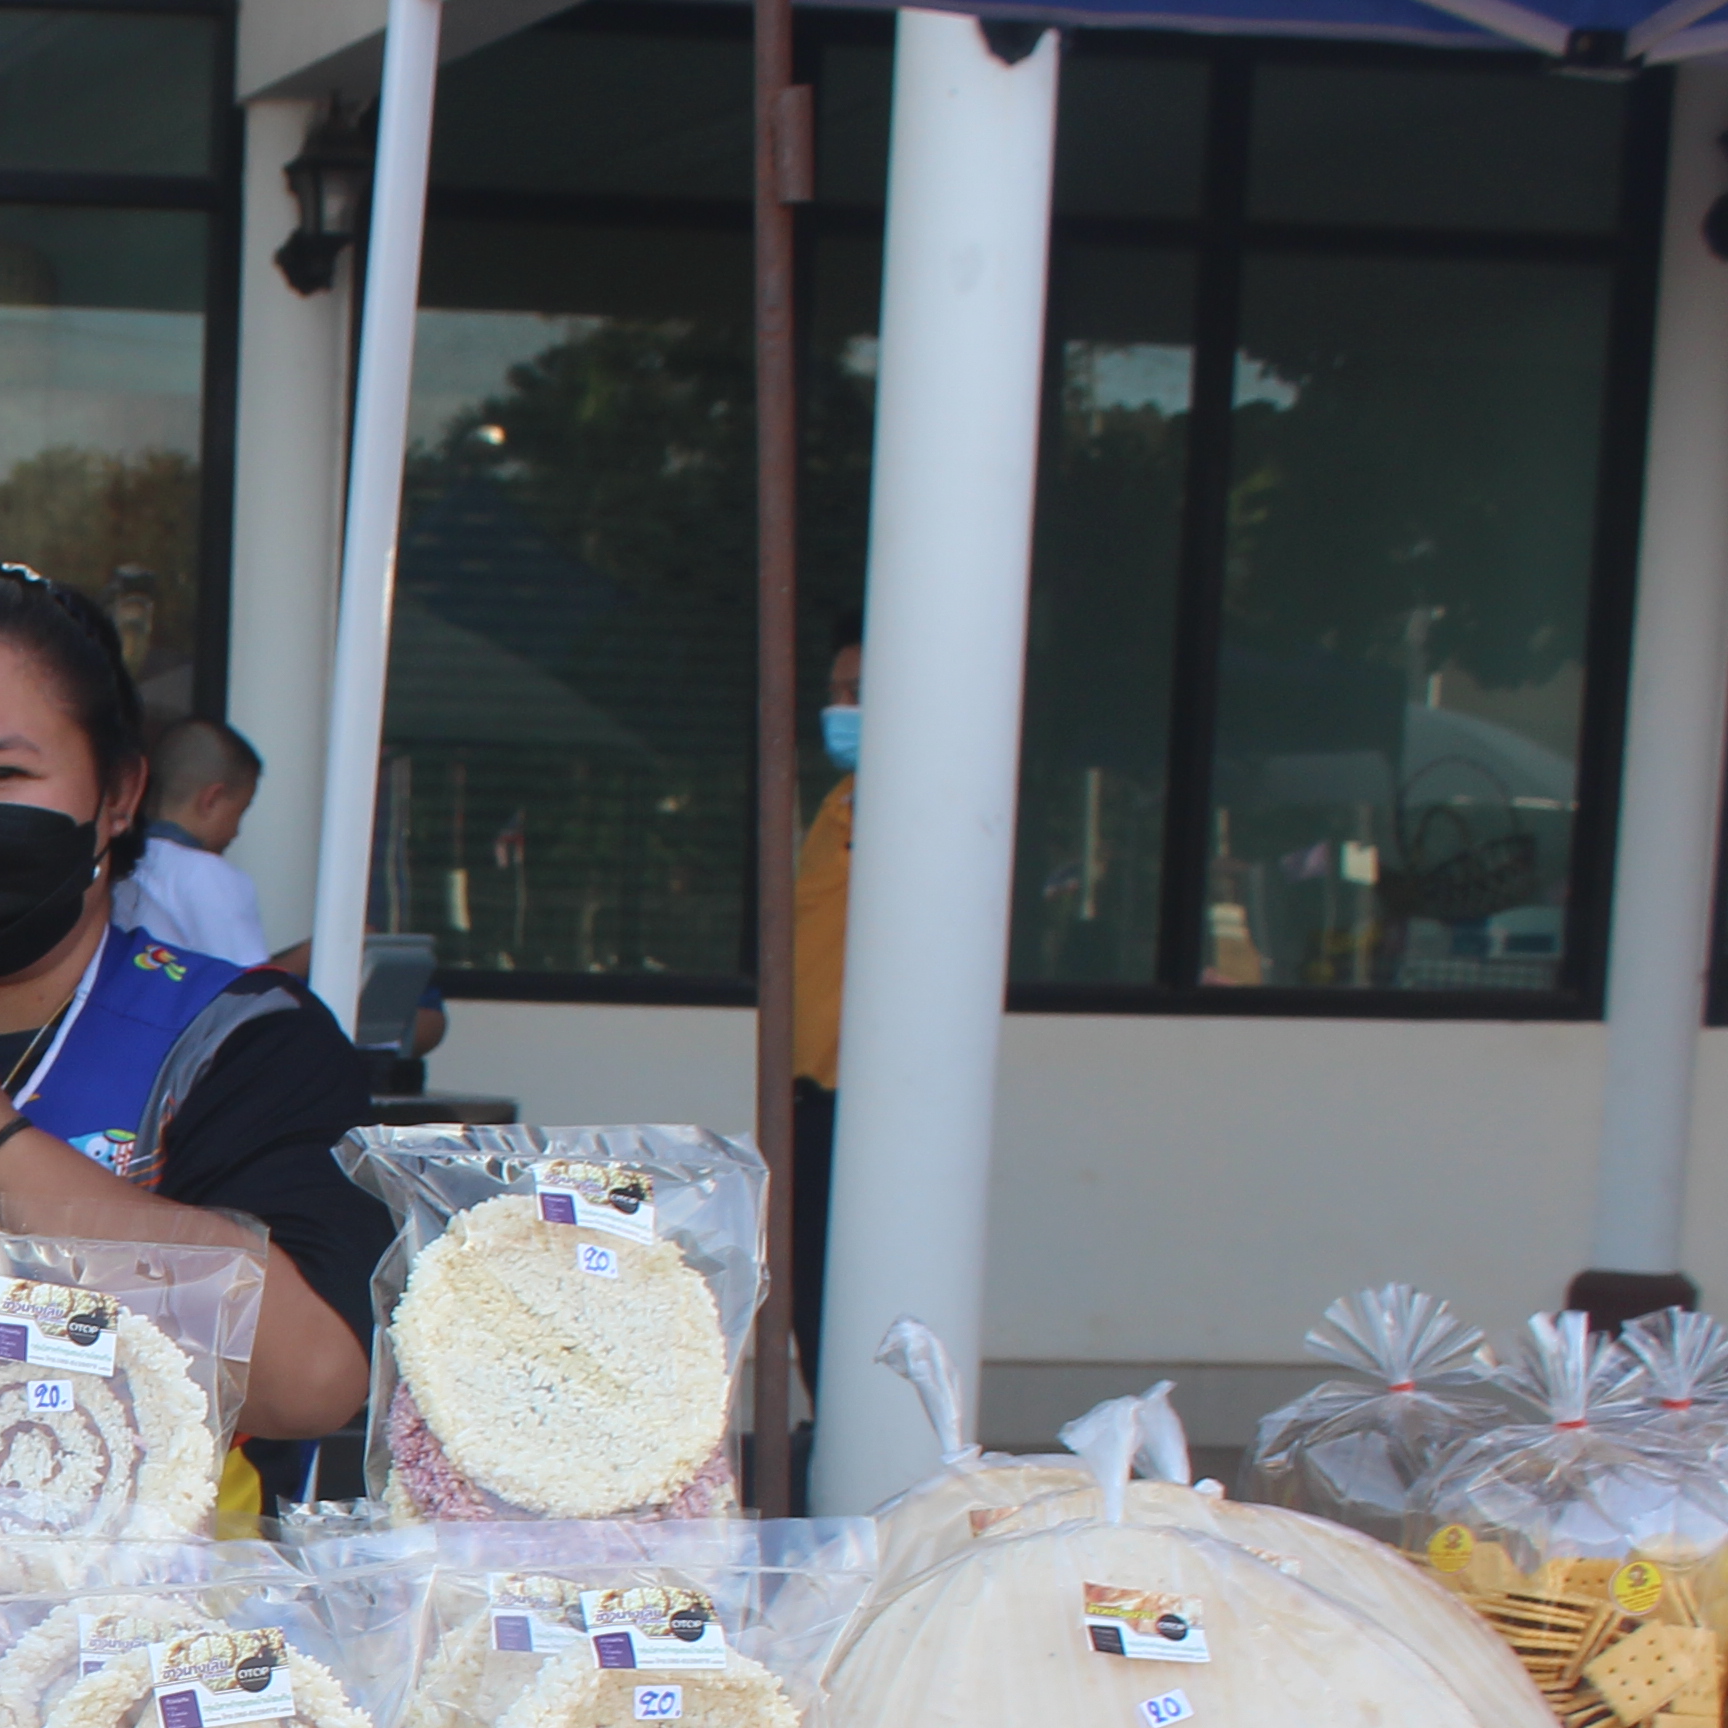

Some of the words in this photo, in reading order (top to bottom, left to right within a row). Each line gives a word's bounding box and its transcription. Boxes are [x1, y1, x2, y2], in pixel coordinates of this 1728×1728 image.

[69, 1322, 100, 1334] OTOP
[238, 1666, 271, 1679] OTOP
[1147, 1696, 1182, 1723] 20
